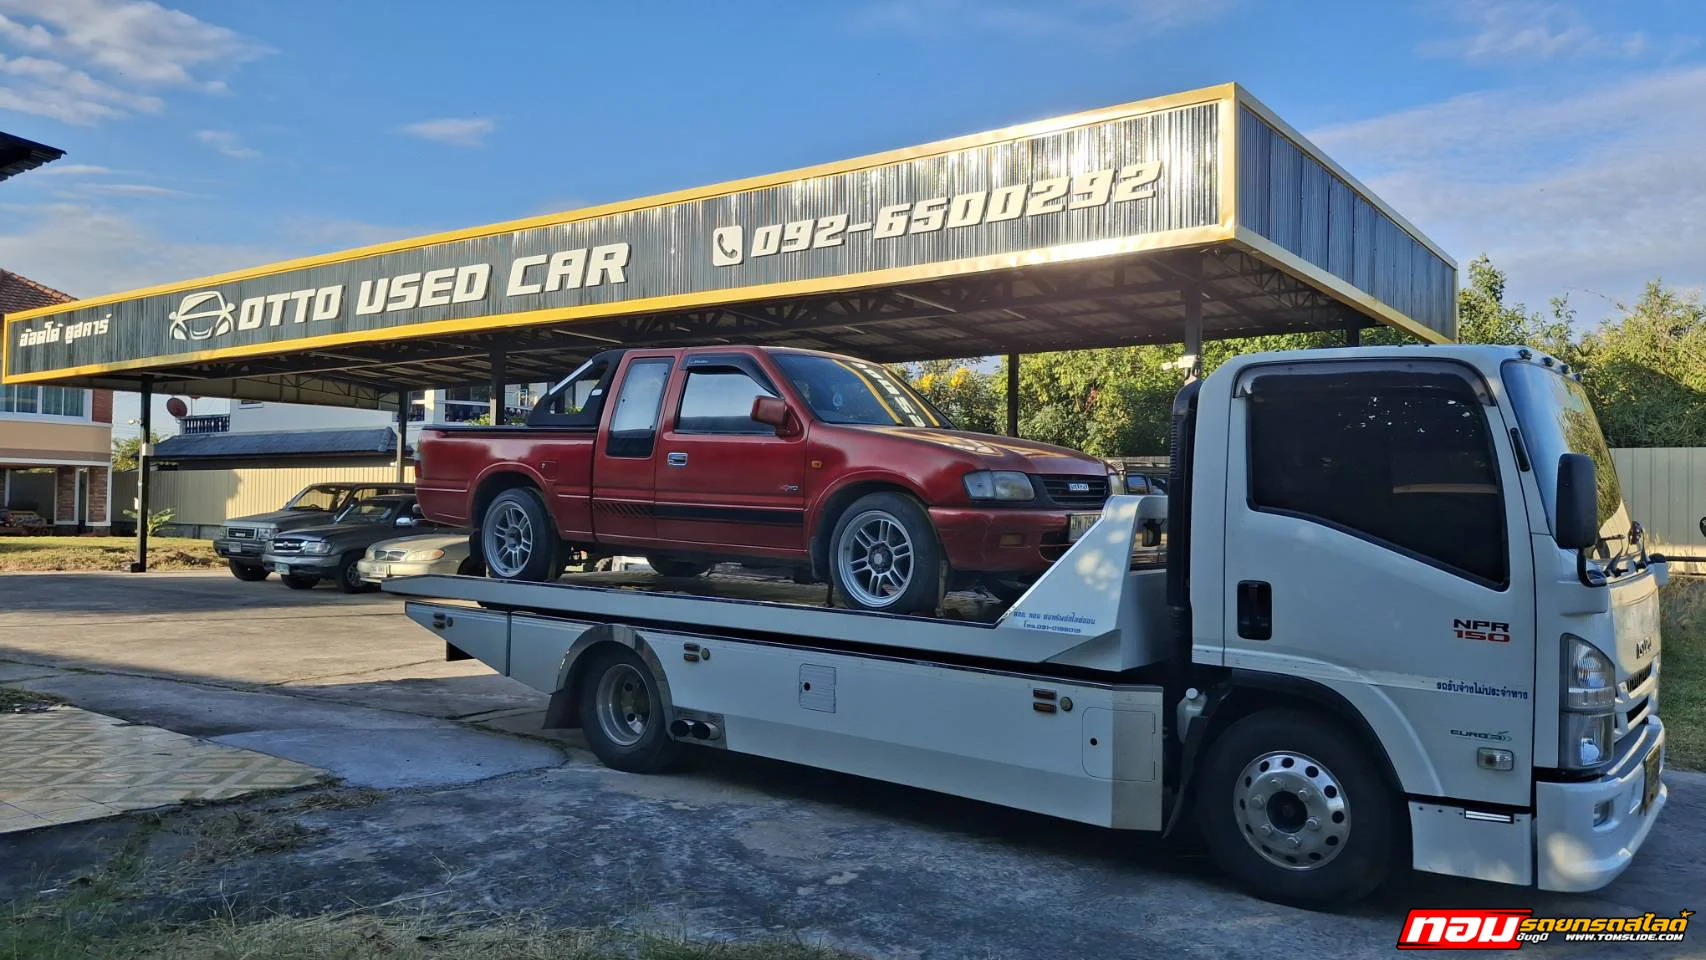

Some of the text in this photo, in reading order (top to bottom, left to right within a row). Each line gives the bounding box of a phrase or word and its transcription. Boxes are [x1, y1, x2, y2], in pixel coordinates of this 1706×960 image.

[750, 160, 1162, 258] 092-6500292
[237, 241, 632, 331] OTTO USED CAR
[1453, 618, 1510, 633] NPR
[1453, 629, 1511, 643] 150
[1436, 679, 1528, 700] รถรับจ้างไม่ประจำทาง
